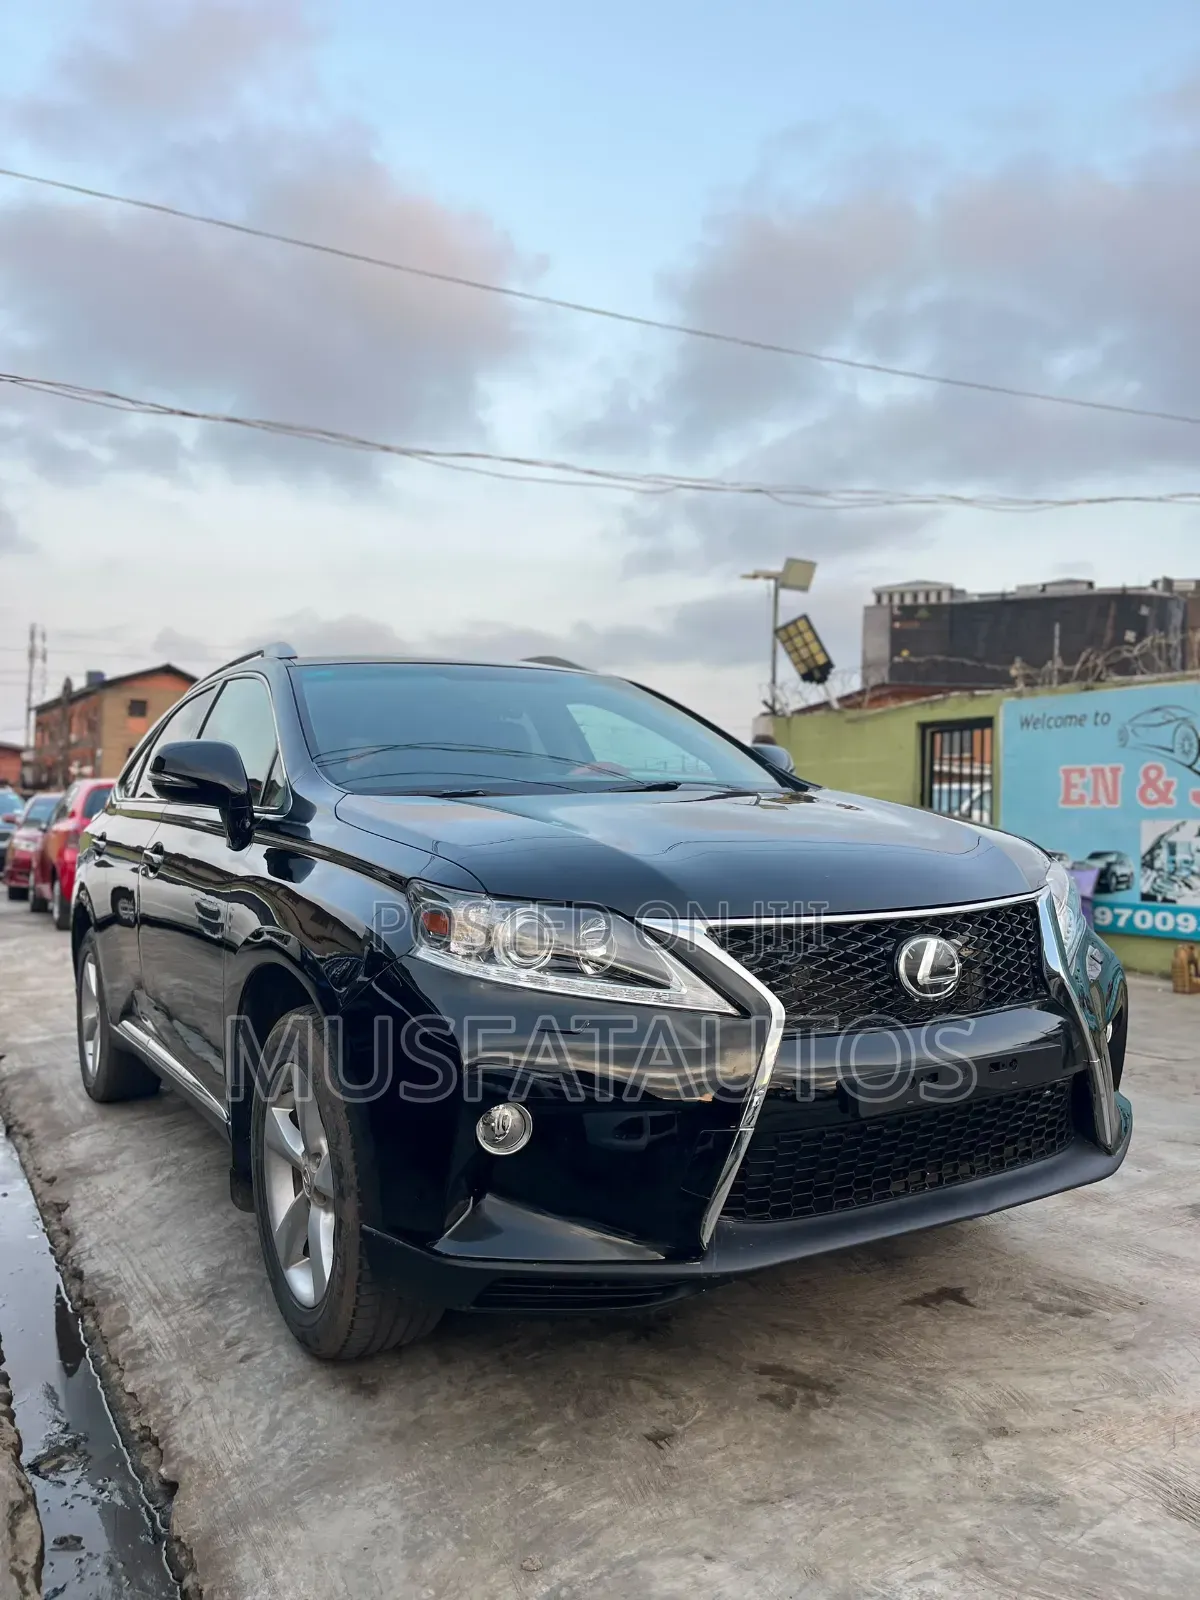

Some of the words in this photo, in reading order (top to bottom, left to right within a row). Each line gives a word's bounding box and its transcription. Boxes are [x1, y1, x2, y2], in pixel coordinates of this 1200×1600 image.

[1020, 712, 1088, 731] Welcome
[1093, 710, 1112, 726] to
[1059, 765, 1123, 808] EN
[1137, 761, 1176, 809] &
[1094, 906, 1200, 933] 97009
